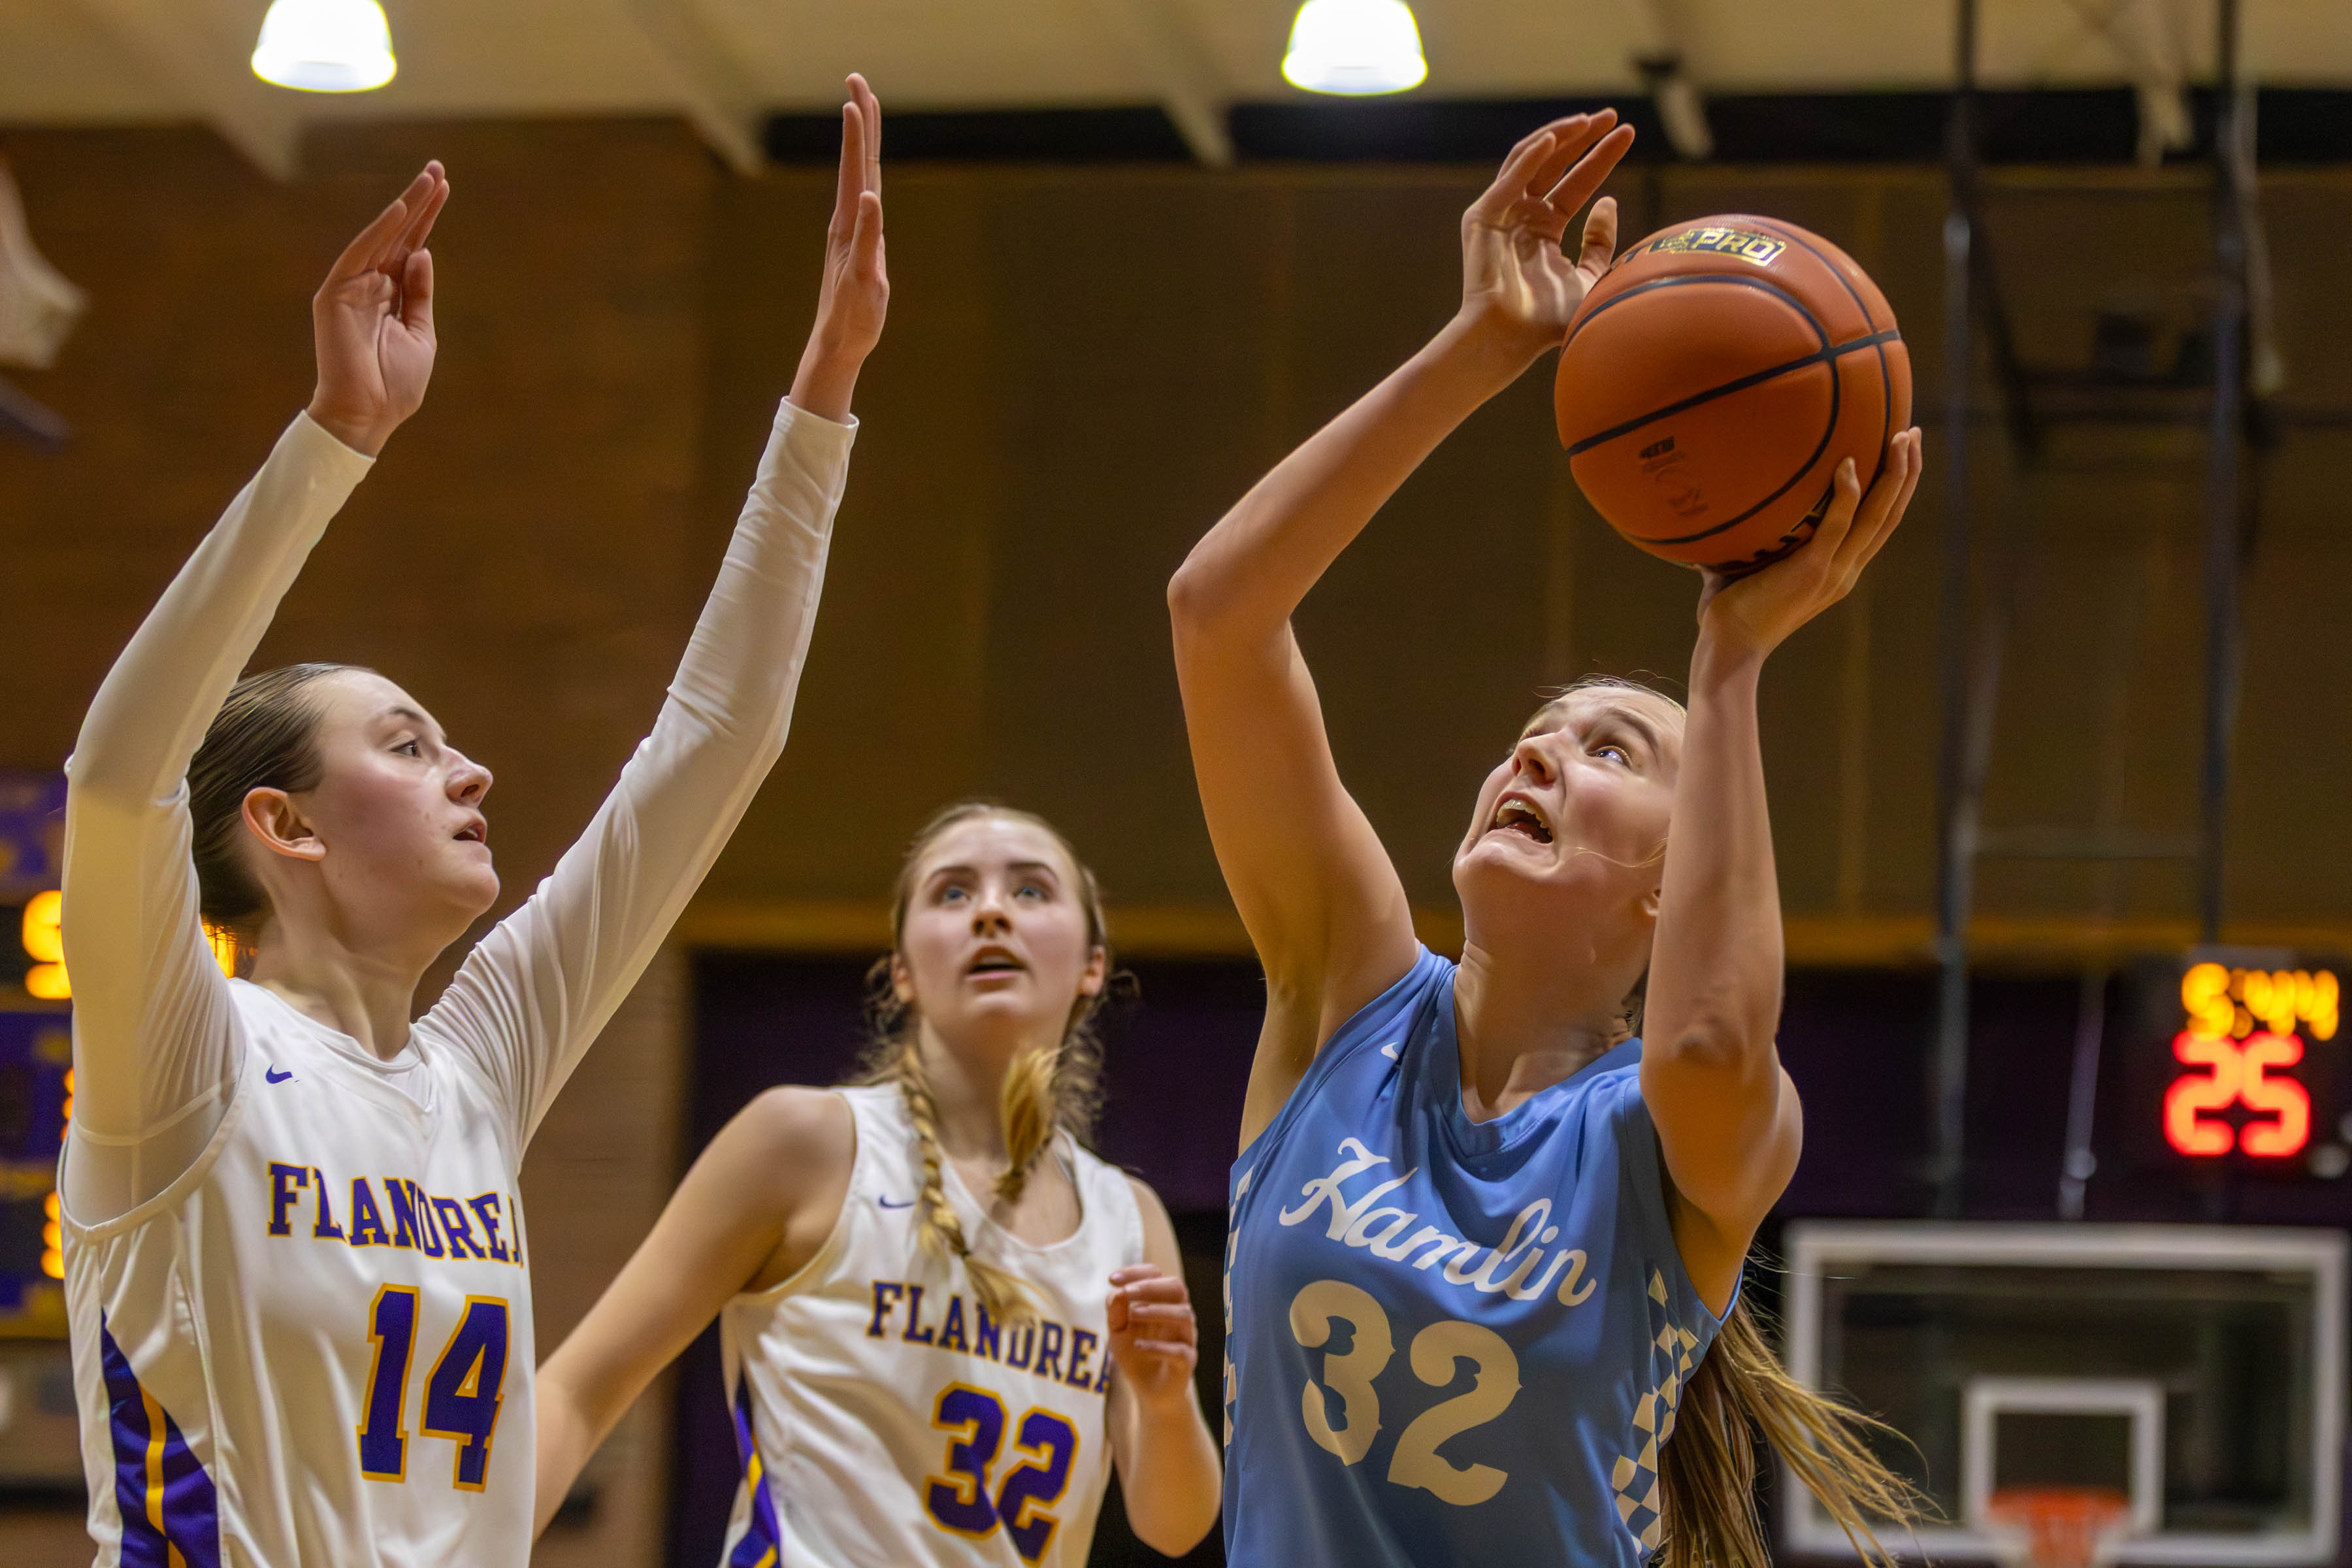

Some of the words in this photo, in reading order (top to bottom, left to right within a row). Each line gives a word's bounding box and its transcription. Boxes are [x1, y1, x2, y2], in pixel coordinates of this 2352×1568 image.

[1691, 229, 1778, 260] PRO
[2164, 1031, 2310, 1156] 25
[1279, 1137, 1596, 1307] Hamlin
[356, 1282, 509, 1492] 14
[923, 1381, 1080, 1568] 32
[1290, 1280, 1523, 1506] 32
